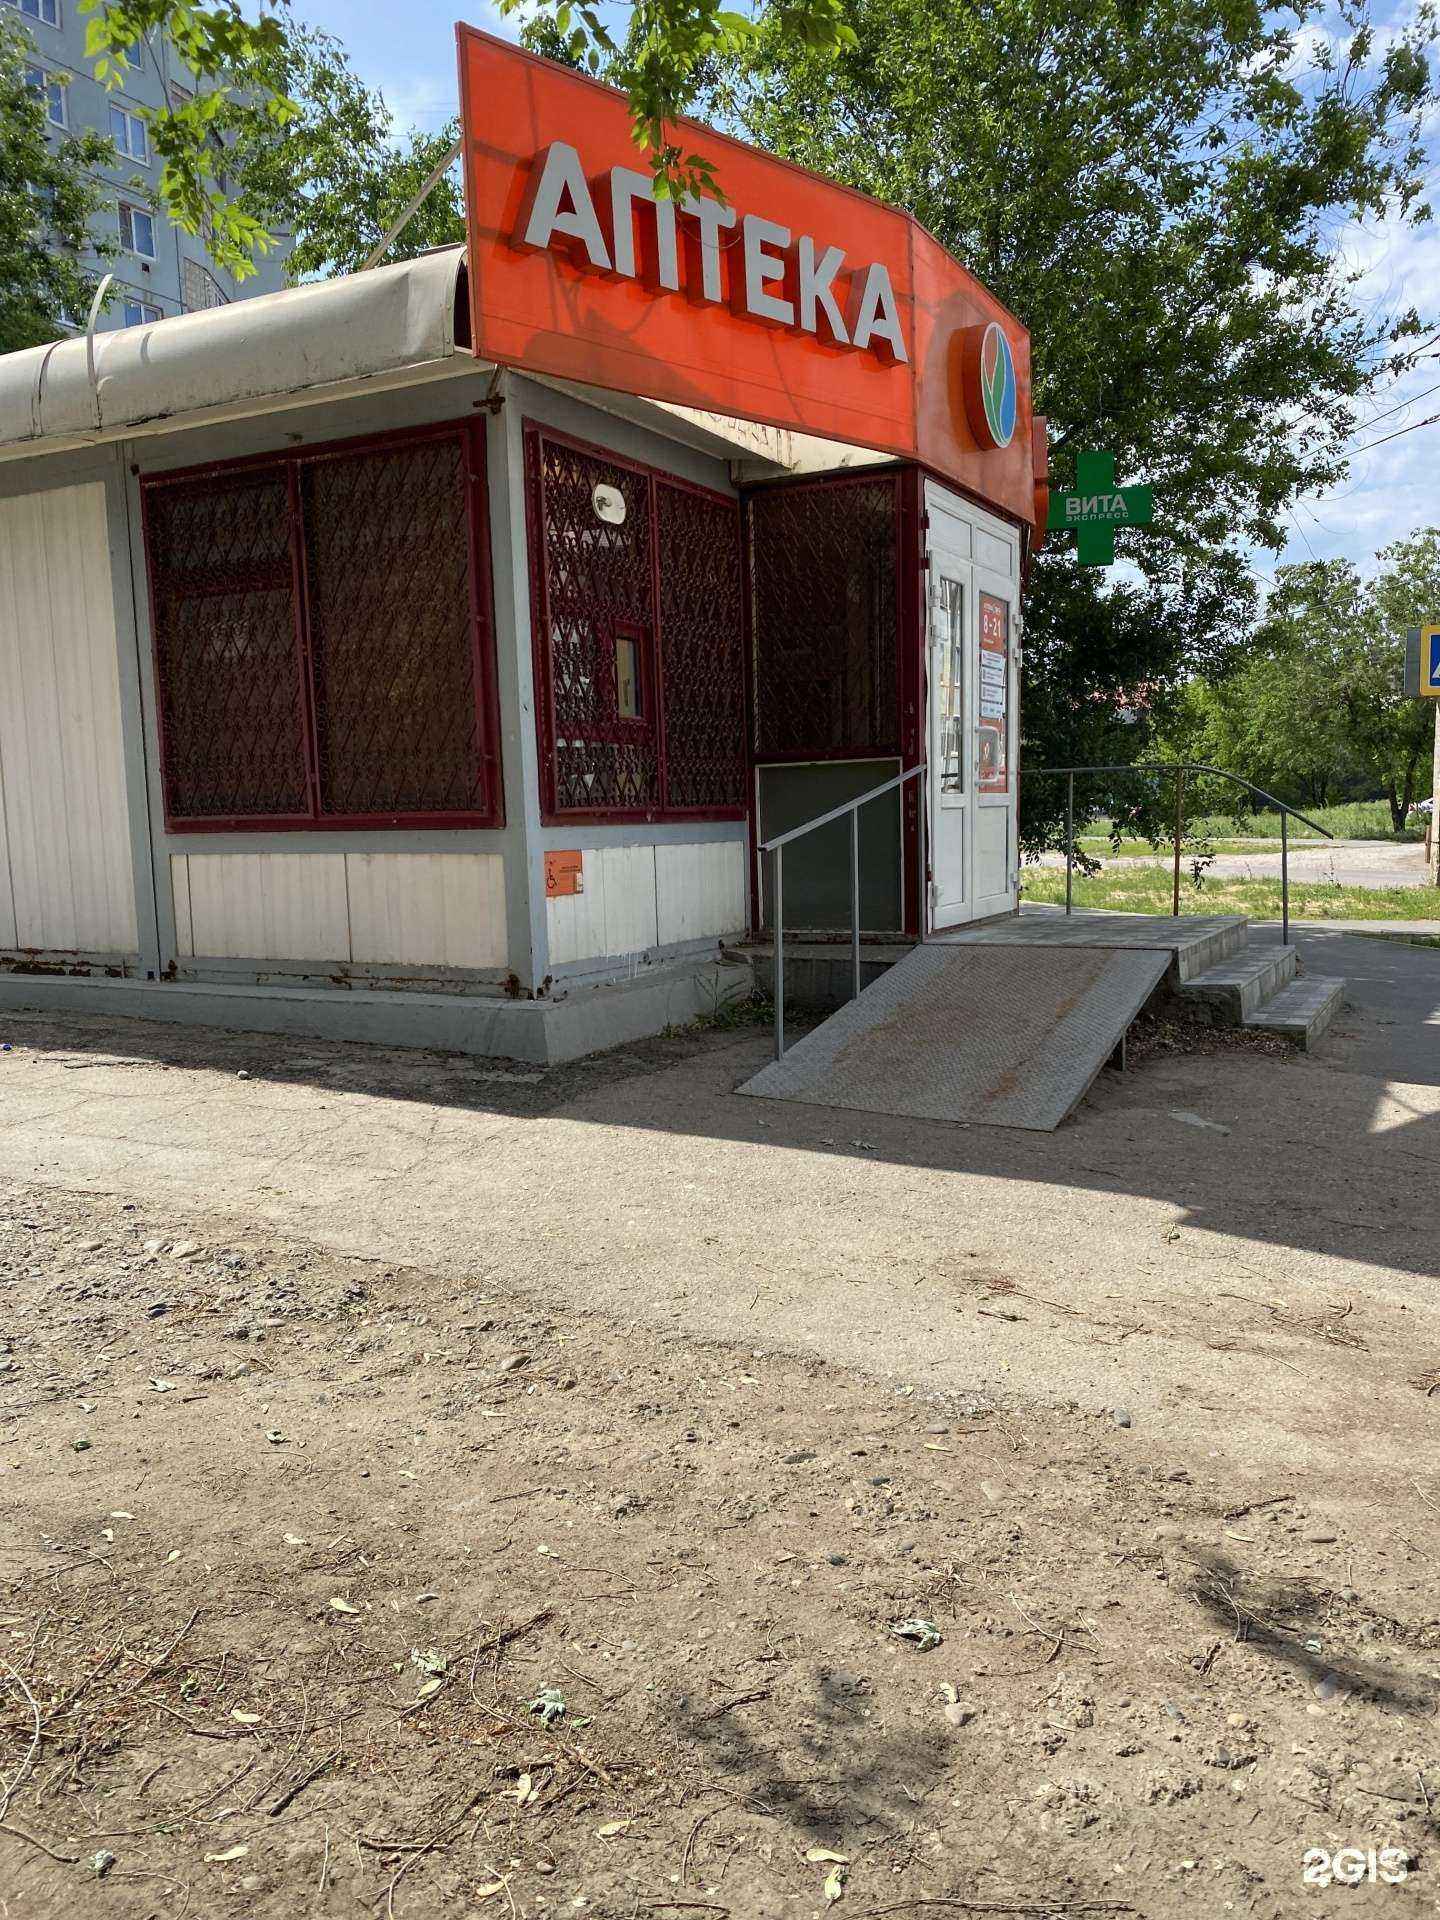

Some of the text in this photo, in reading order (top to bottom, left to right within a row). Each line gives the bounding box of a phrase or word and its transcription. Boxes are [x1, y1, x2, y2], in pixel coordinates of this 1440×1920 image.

[524, 141, 909, 363] АПТЕКА
[1065, 494, 1128, 515] ВИТА
[1065, 511, 1129, 522] ЭКСПРЕСС
